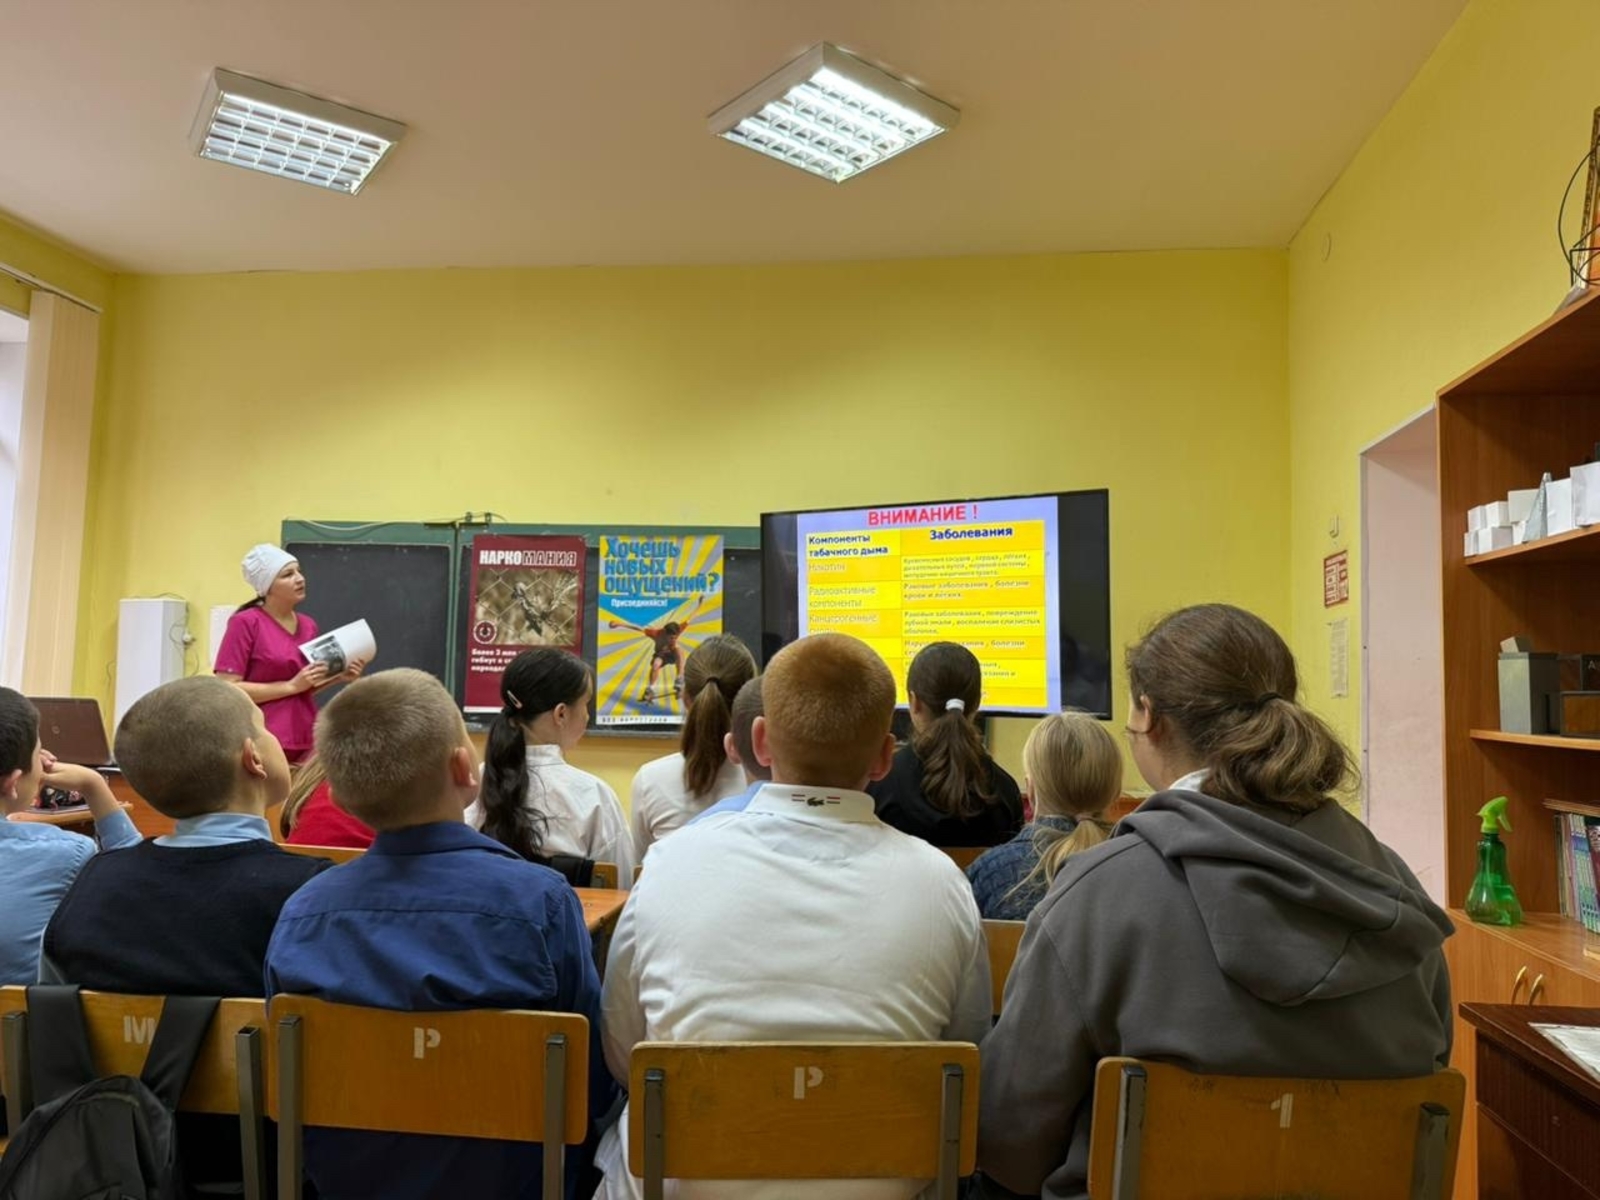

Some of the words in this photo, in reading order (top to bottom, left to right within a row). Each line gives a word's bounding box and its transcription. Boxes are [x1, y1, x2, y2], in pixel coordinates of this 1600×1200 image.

[868, 505, 967, 526] ВНИМАНИЕ
[808, 533, 870, 545] Компоненты
[929, 527, 1013, 541] Заболевания
[604, 535, 680, 558] Хочешь
[809, 547, 859, 558] табачного
[860, 546, 888, 557] дыма
[479, 550, 577, 567] НАРКОМАНИЯ
[604, 557, 666, 576] новых
[604, 572, 721, 596] ощущений?
[1270, 1093, 1294, 1128] 1
